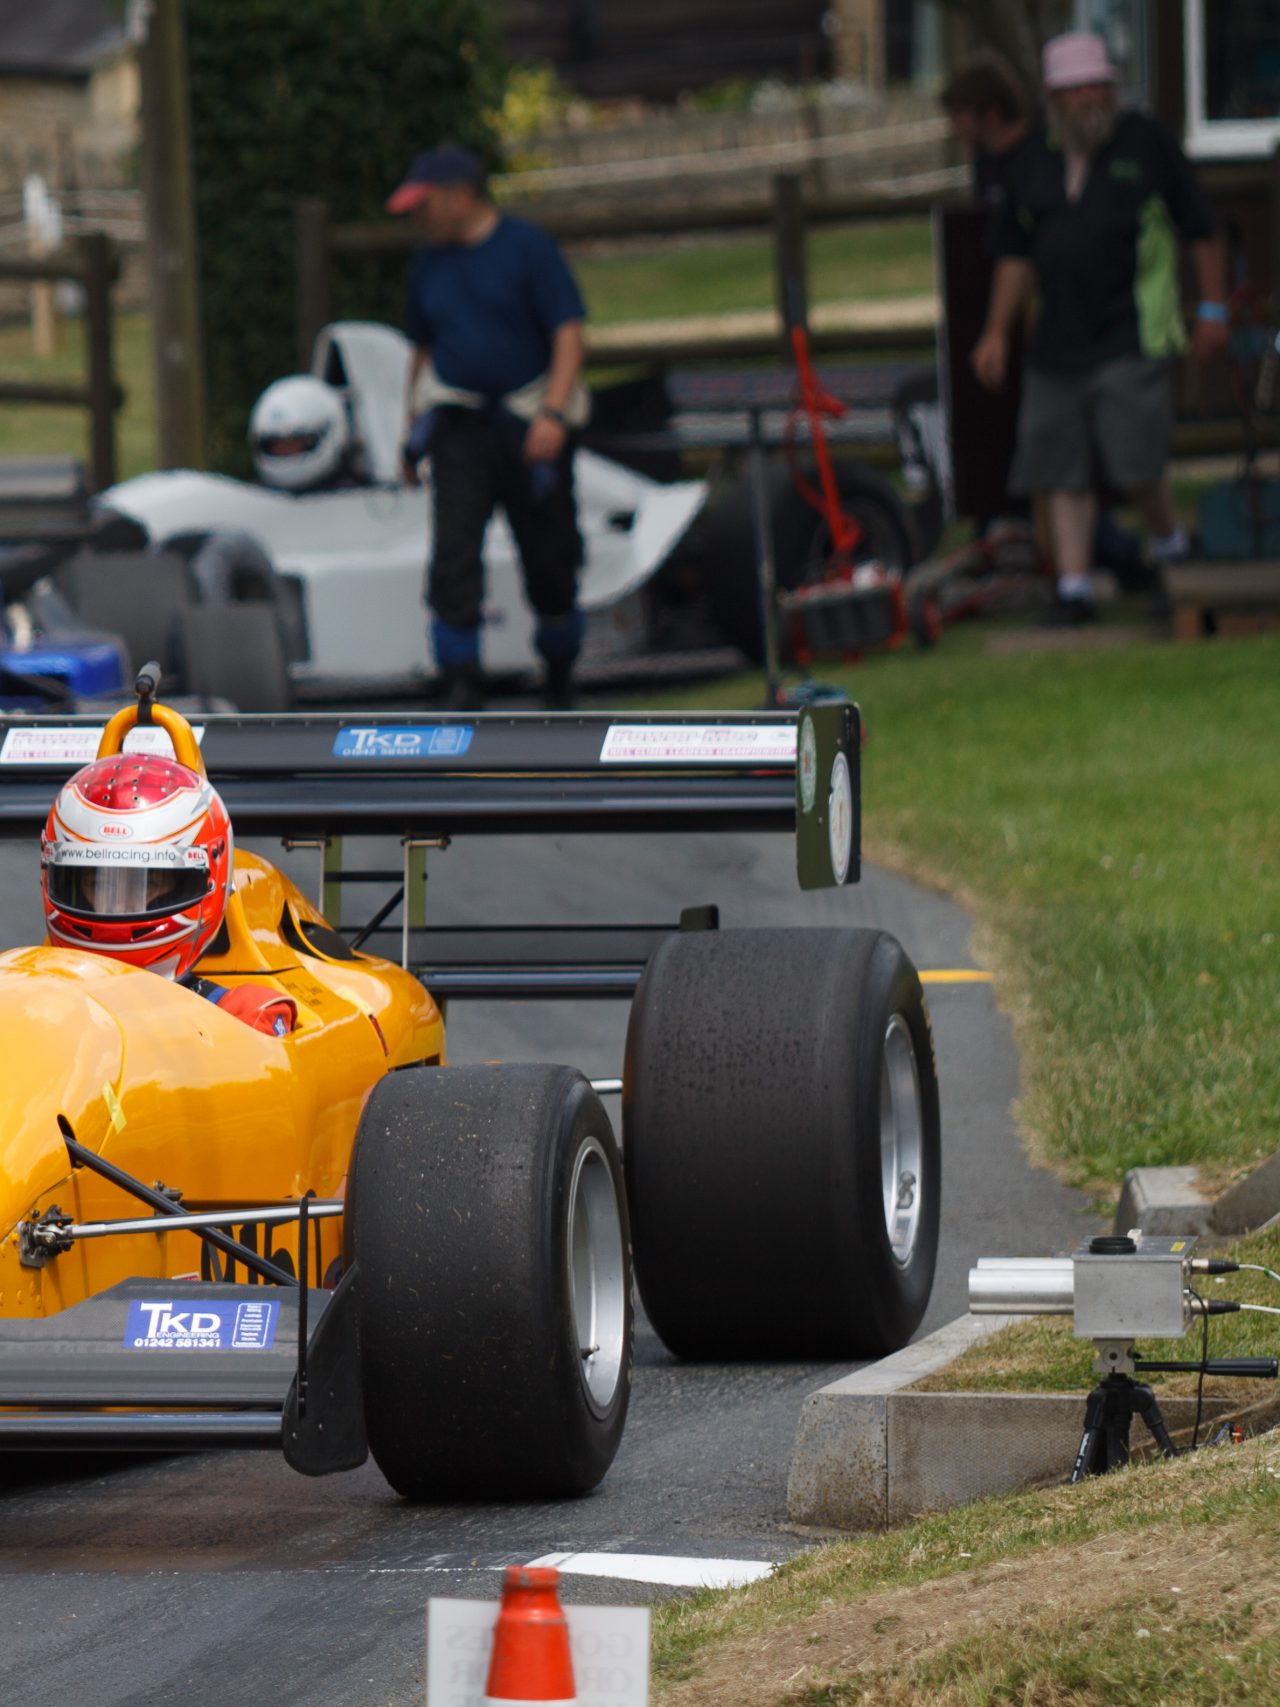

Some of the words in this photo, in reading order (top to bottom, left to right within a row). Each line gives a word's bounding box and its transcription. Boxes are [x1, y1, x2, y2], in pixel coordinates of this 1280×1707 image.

[349, 728, 421, 751] TKD
[103, 825, 128, 835] BELL
[61, 848, 176, 863] www.bellracing.info
[187, 850, 205, 860] BELL
[140, 1302, 221, 1338] TKD
[134, 1338, 174, 1347] 01242
[175, 1338, 220, 1347] 581341
